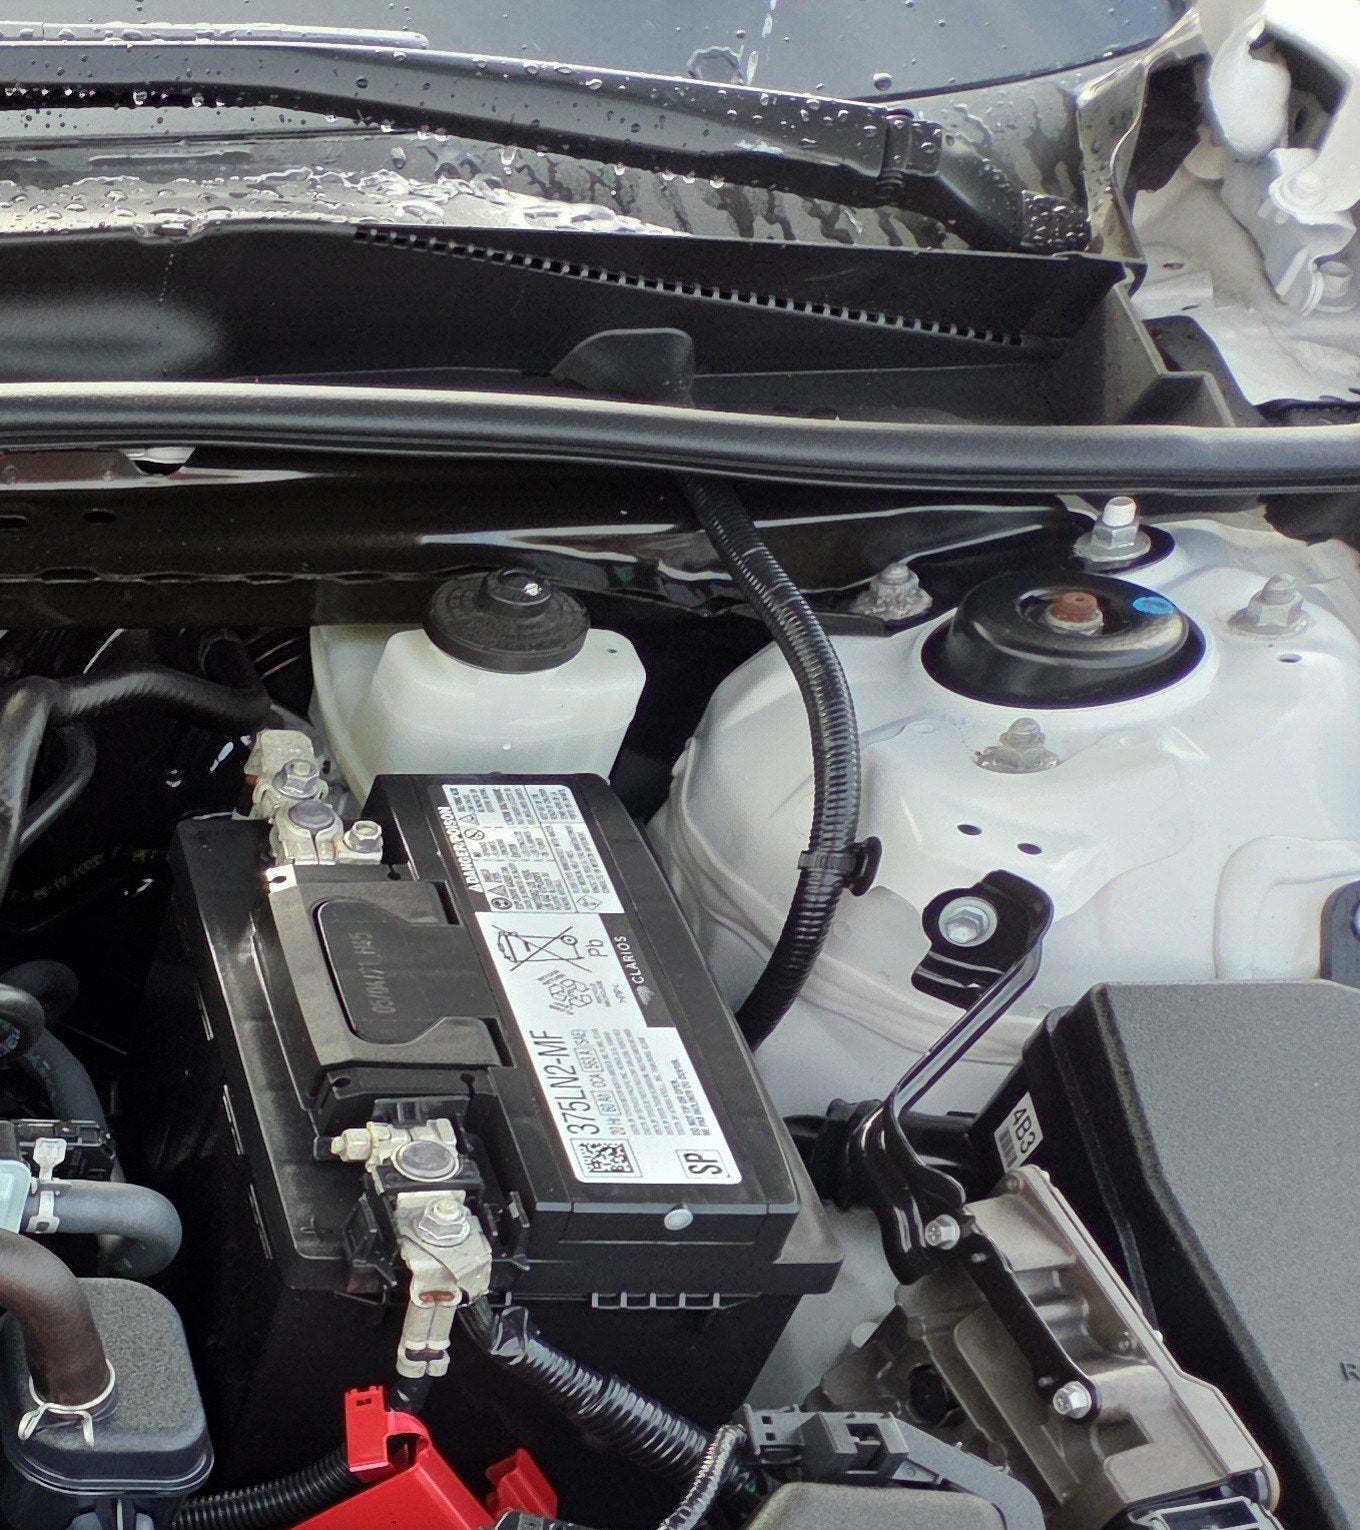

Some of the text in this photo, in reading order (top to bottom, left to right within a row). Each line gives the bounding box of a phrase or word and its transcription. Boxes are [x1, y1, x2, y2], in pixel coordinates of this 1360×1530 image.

[585, 939, 608, 957] Pb
[613, 935, 645, 985] CLARIOS
[529, 1029, 601, 1135] 375LN2-MF
[1013, 1108, 1036, 1154] 4B3
[683, 1152, 723, 1176] SP
